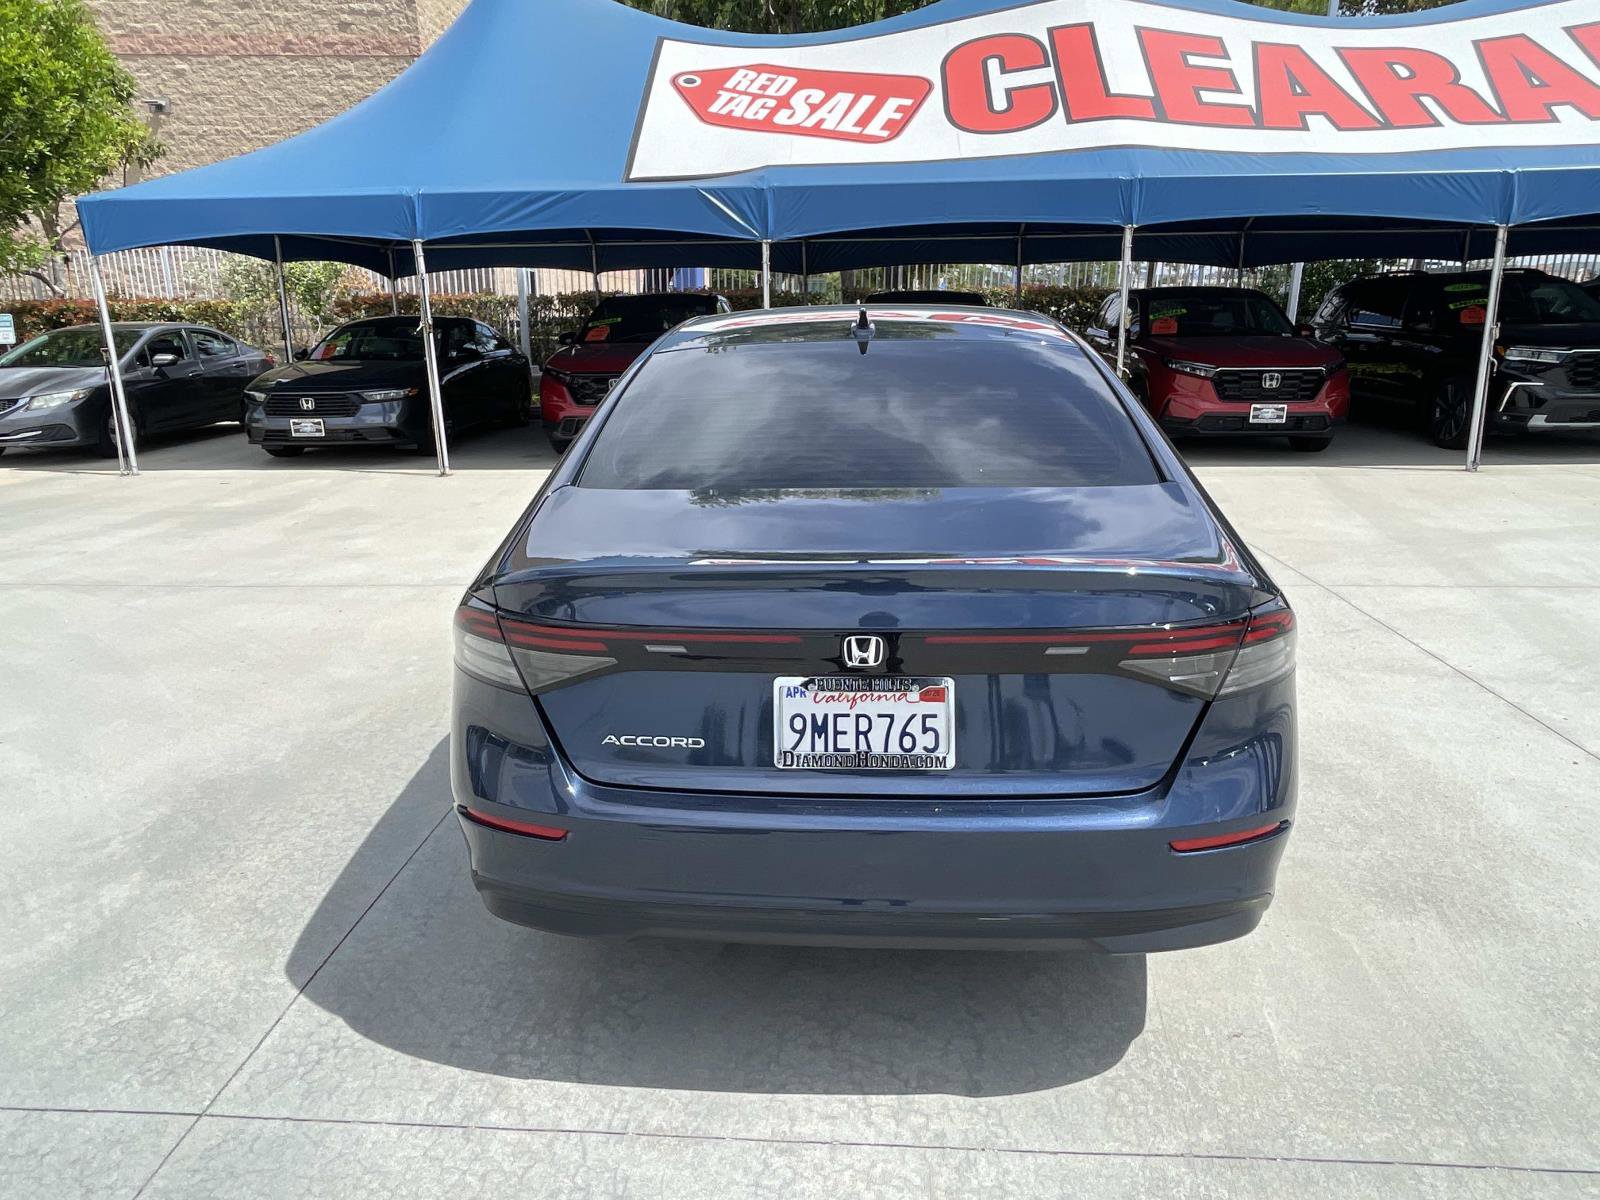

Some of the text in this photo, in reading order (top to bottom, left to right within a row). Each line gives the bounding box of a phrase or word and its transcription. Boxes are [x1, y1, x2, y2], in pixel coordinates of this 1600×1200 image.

[723, 68, 799, 98] RED
[707, 90, 778, 121] TAG
[772, 88, 914, 138] SALE
[785, 686, 807, 699] APR
[815, 678, 912, 692] PUENTE HILLS
[601, 734, 706, 749] ACCORD
[789, 712, 940, 754] 9MER765
